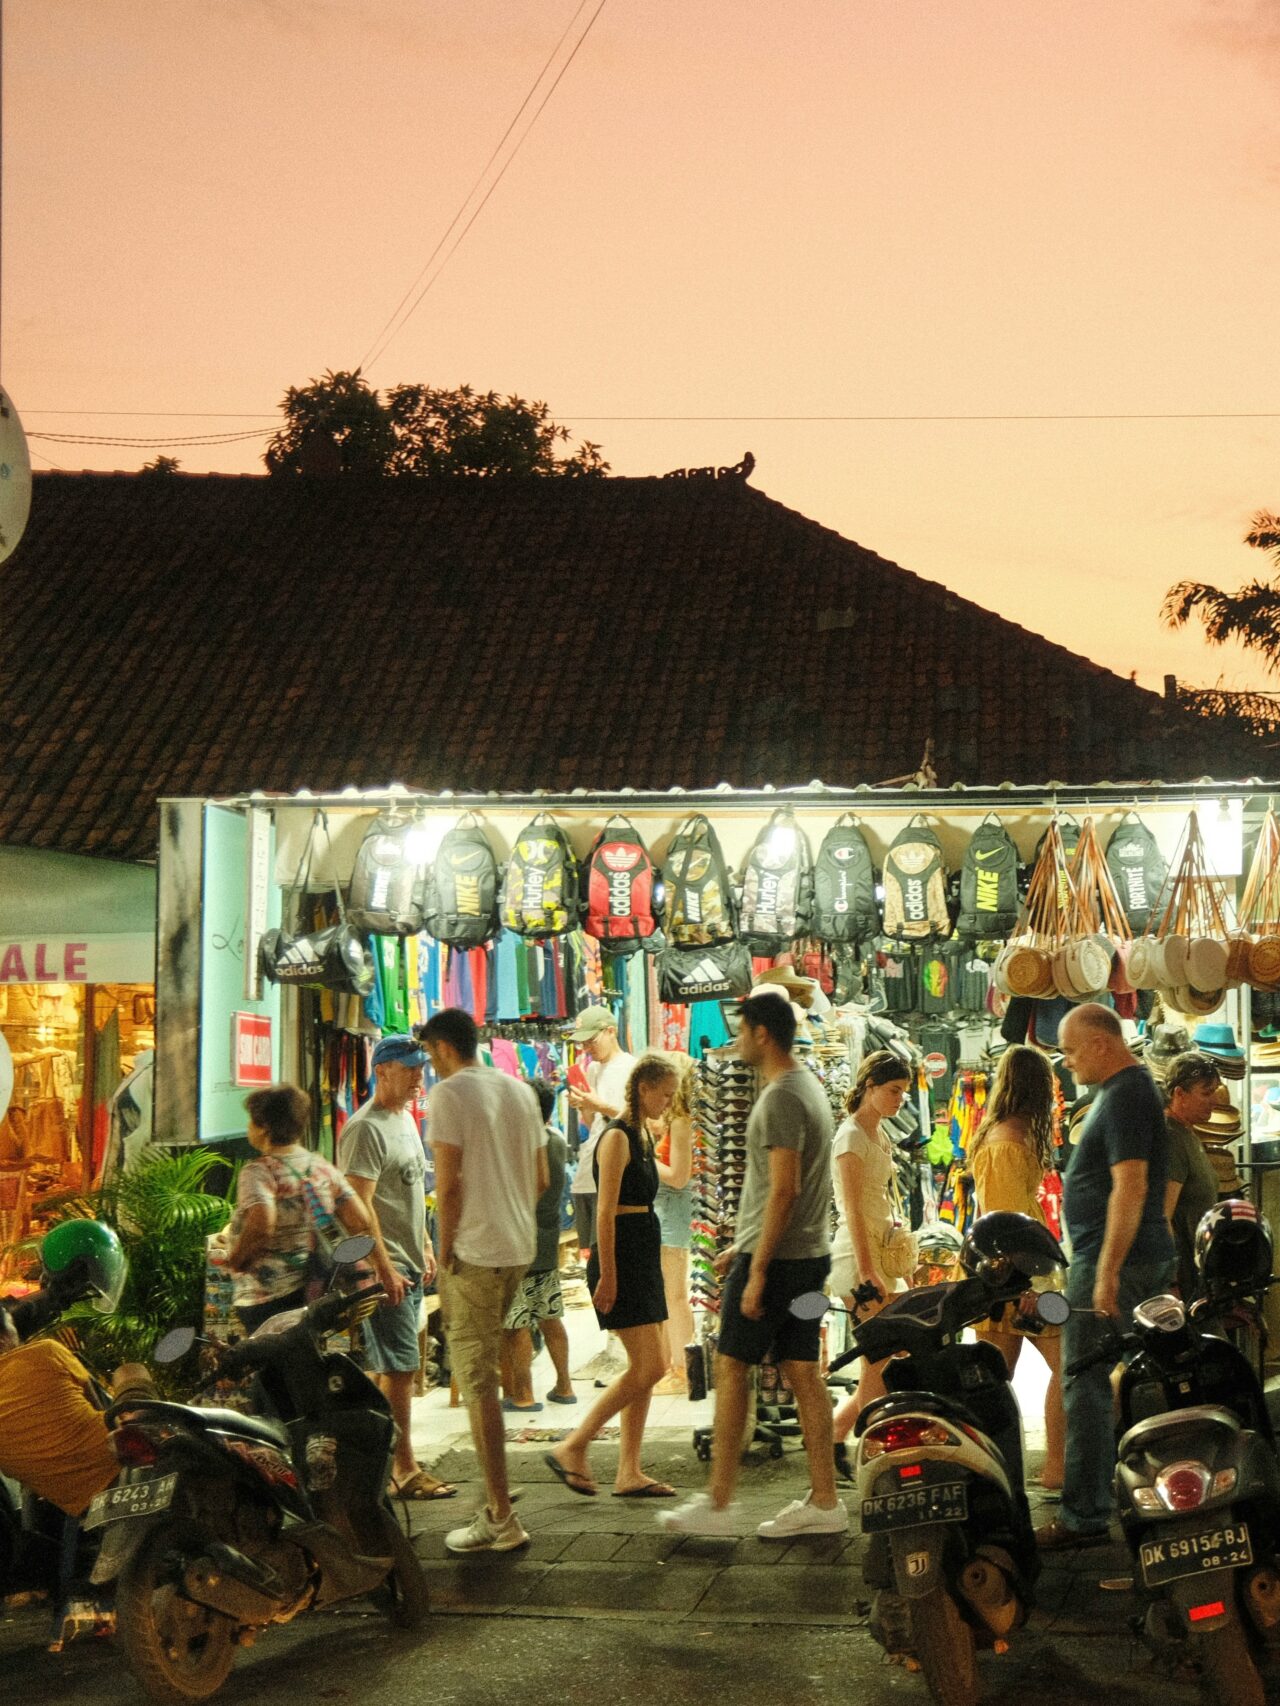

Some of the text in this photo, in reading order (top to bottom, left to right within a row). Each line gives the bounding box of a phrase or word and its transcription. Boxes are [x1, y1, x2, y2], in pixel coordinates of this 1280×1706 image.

[455, 874, 481, 916] NIKE
[523, 868, 547, 910] Hurley
[608, 871, 631, 916] adidas
[756, 872, 780, 915] Hurley
[905, 878, 925, 920] adidas
[976, 869, 999, 912] NIKE
[1130, 867, 1148, 910] FORTNITE
[275, 962, 326, 977] adidas
[678, 981, 731, 995] adidas
[111, 1485, 150, 1504] 6243
[863, 1499, 884, 1516] DK
[887, 1491, 927, 1511] 6236
[1144, 1544, 1166, 1567] DK
[1169, 1535, 1211, 1558] 6915
